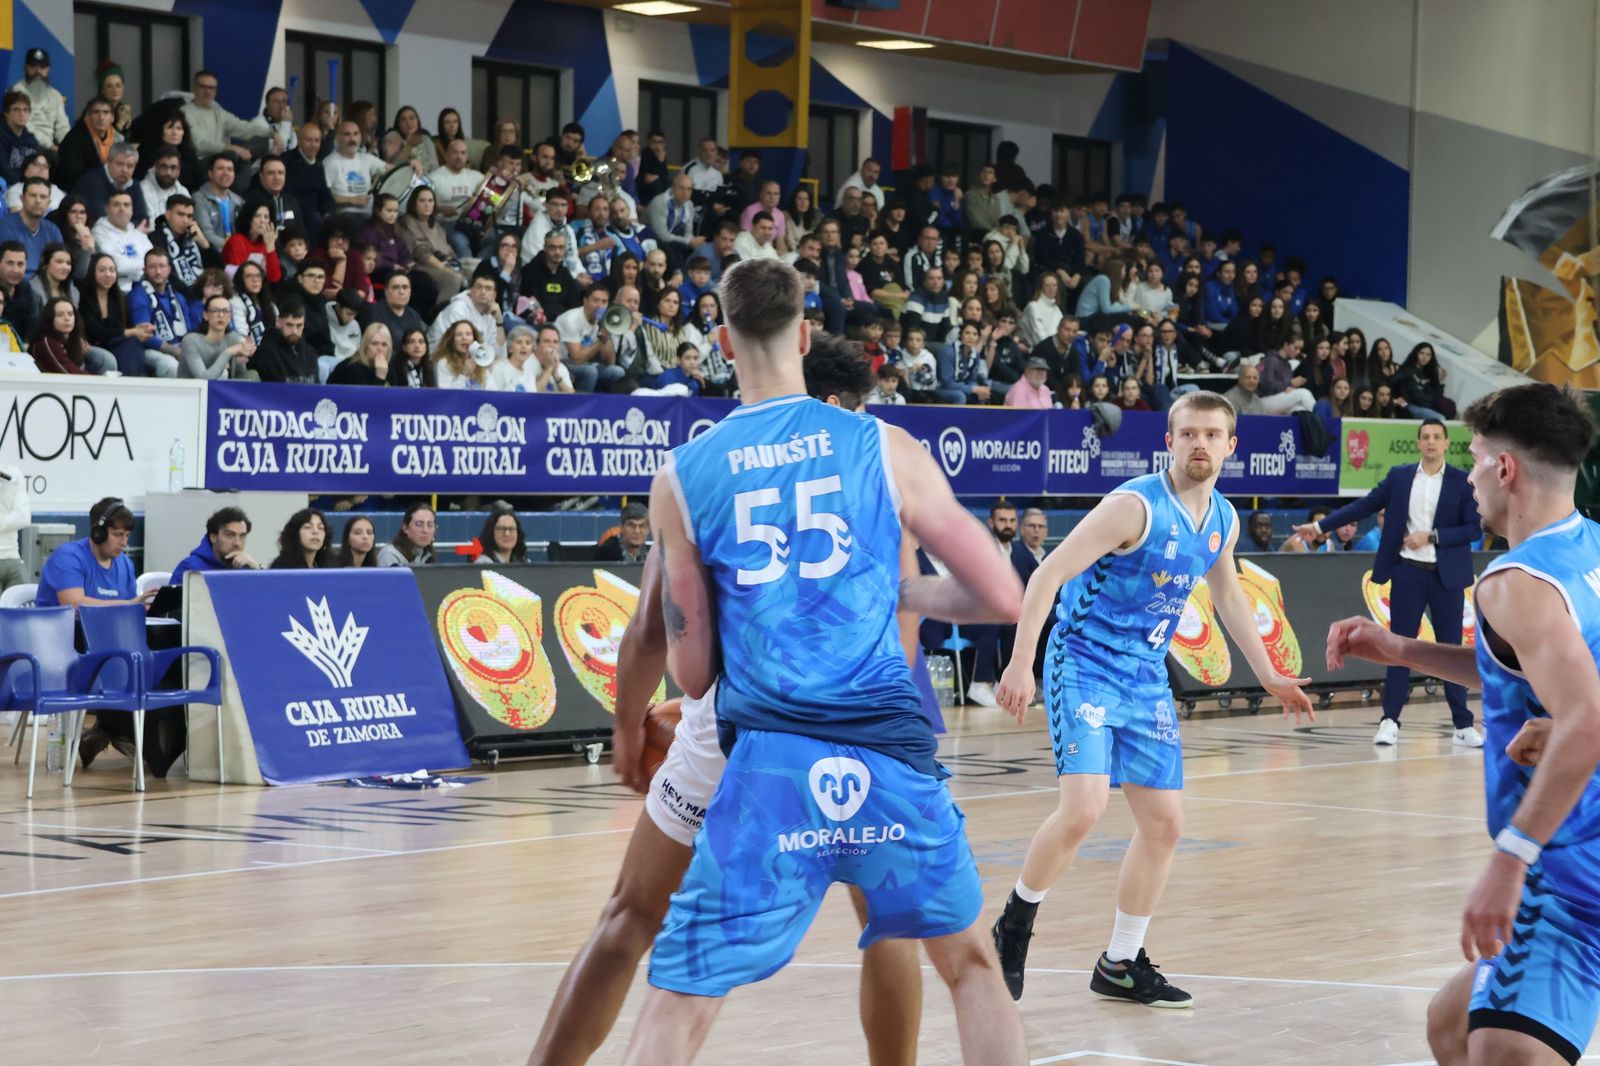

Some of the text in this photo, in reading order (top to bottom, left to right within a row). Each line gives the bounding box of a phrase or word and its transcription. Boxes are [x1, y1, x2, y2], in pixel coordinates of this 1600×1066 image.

[217, 440, 369, 476] CAJA RURAL
[391, 444, 526, 478] CAJA RURAL
[546, 446, 597, 478] CAJA
[727, 429, 833, 475] PAUKŠTĖ
[971, 439, 1041, 460] MORALEJO
[1048, 449, 1089, 474] FITECU
[1250, 452, 1286, 477] FITECU
[734, 475, 852, 585] 55
[285, 693, 417, 726] CAJA RURAL
[305, 722, 404, 748] DE ZAMORA
[685, 801, 707, 819] MA
[778, 823, 906, 852] MORALEJO
[816, 847, 868, 858] SELECCIÓN
